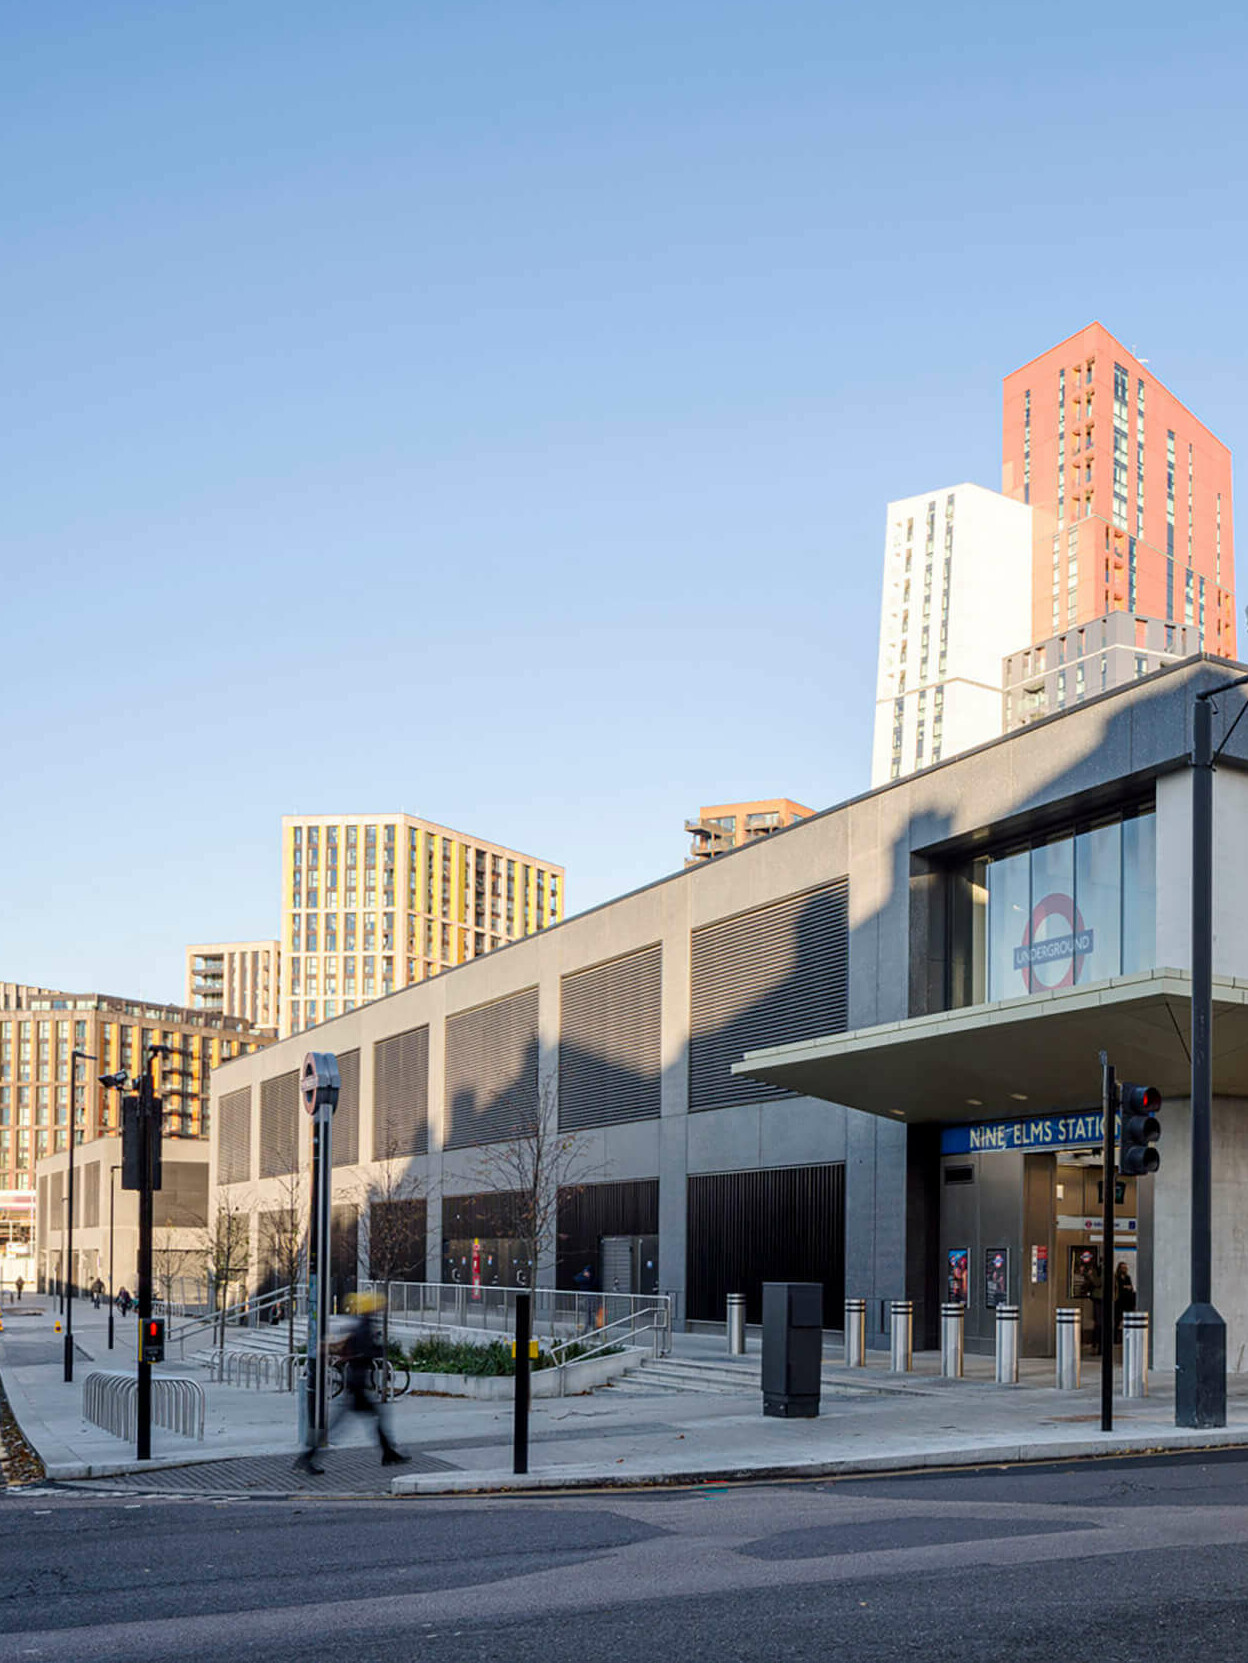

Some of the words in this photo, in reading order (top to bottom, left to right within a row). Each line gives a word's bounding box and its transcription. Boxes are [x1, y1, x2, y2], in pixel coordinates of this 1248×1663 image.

[1016, 935, 1090, 964] UNDERGROUND
[970, 1126, 1005, 1148] NINE
[1013, 1121, 1052, 1144] ELMS
